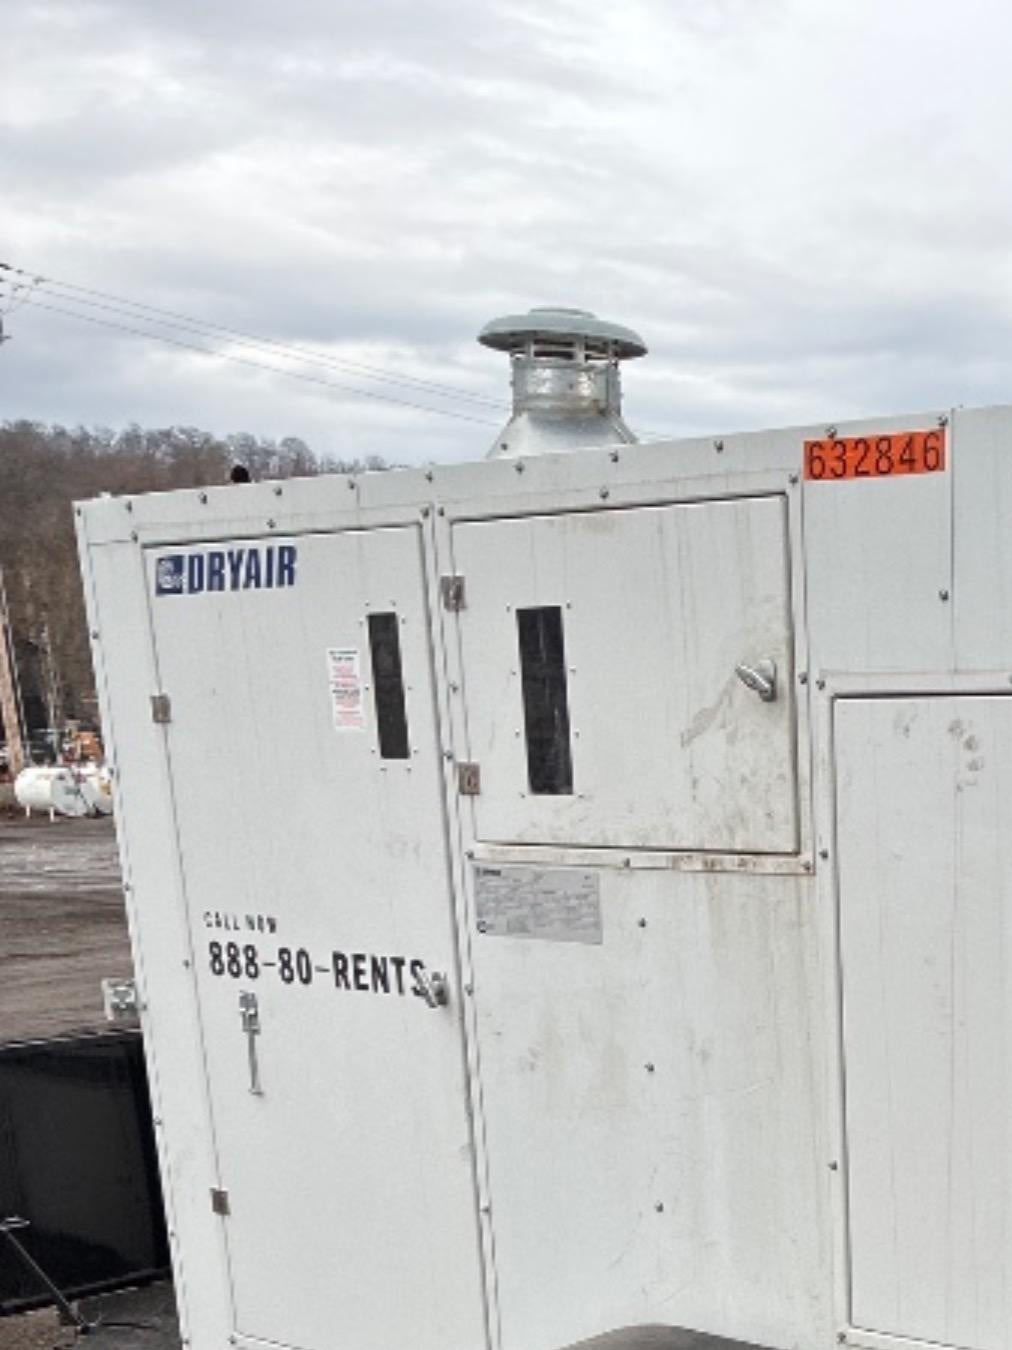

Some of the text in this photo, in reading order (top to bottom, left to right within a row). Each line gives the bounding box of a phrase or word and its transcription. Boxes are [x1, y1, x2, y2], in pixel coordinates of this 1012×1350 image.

[809, 431, 940, 480] 632846
[187, 545, 298, 594] DRYAIR
[208, 941, 428, 997] 888-80-RENTS
